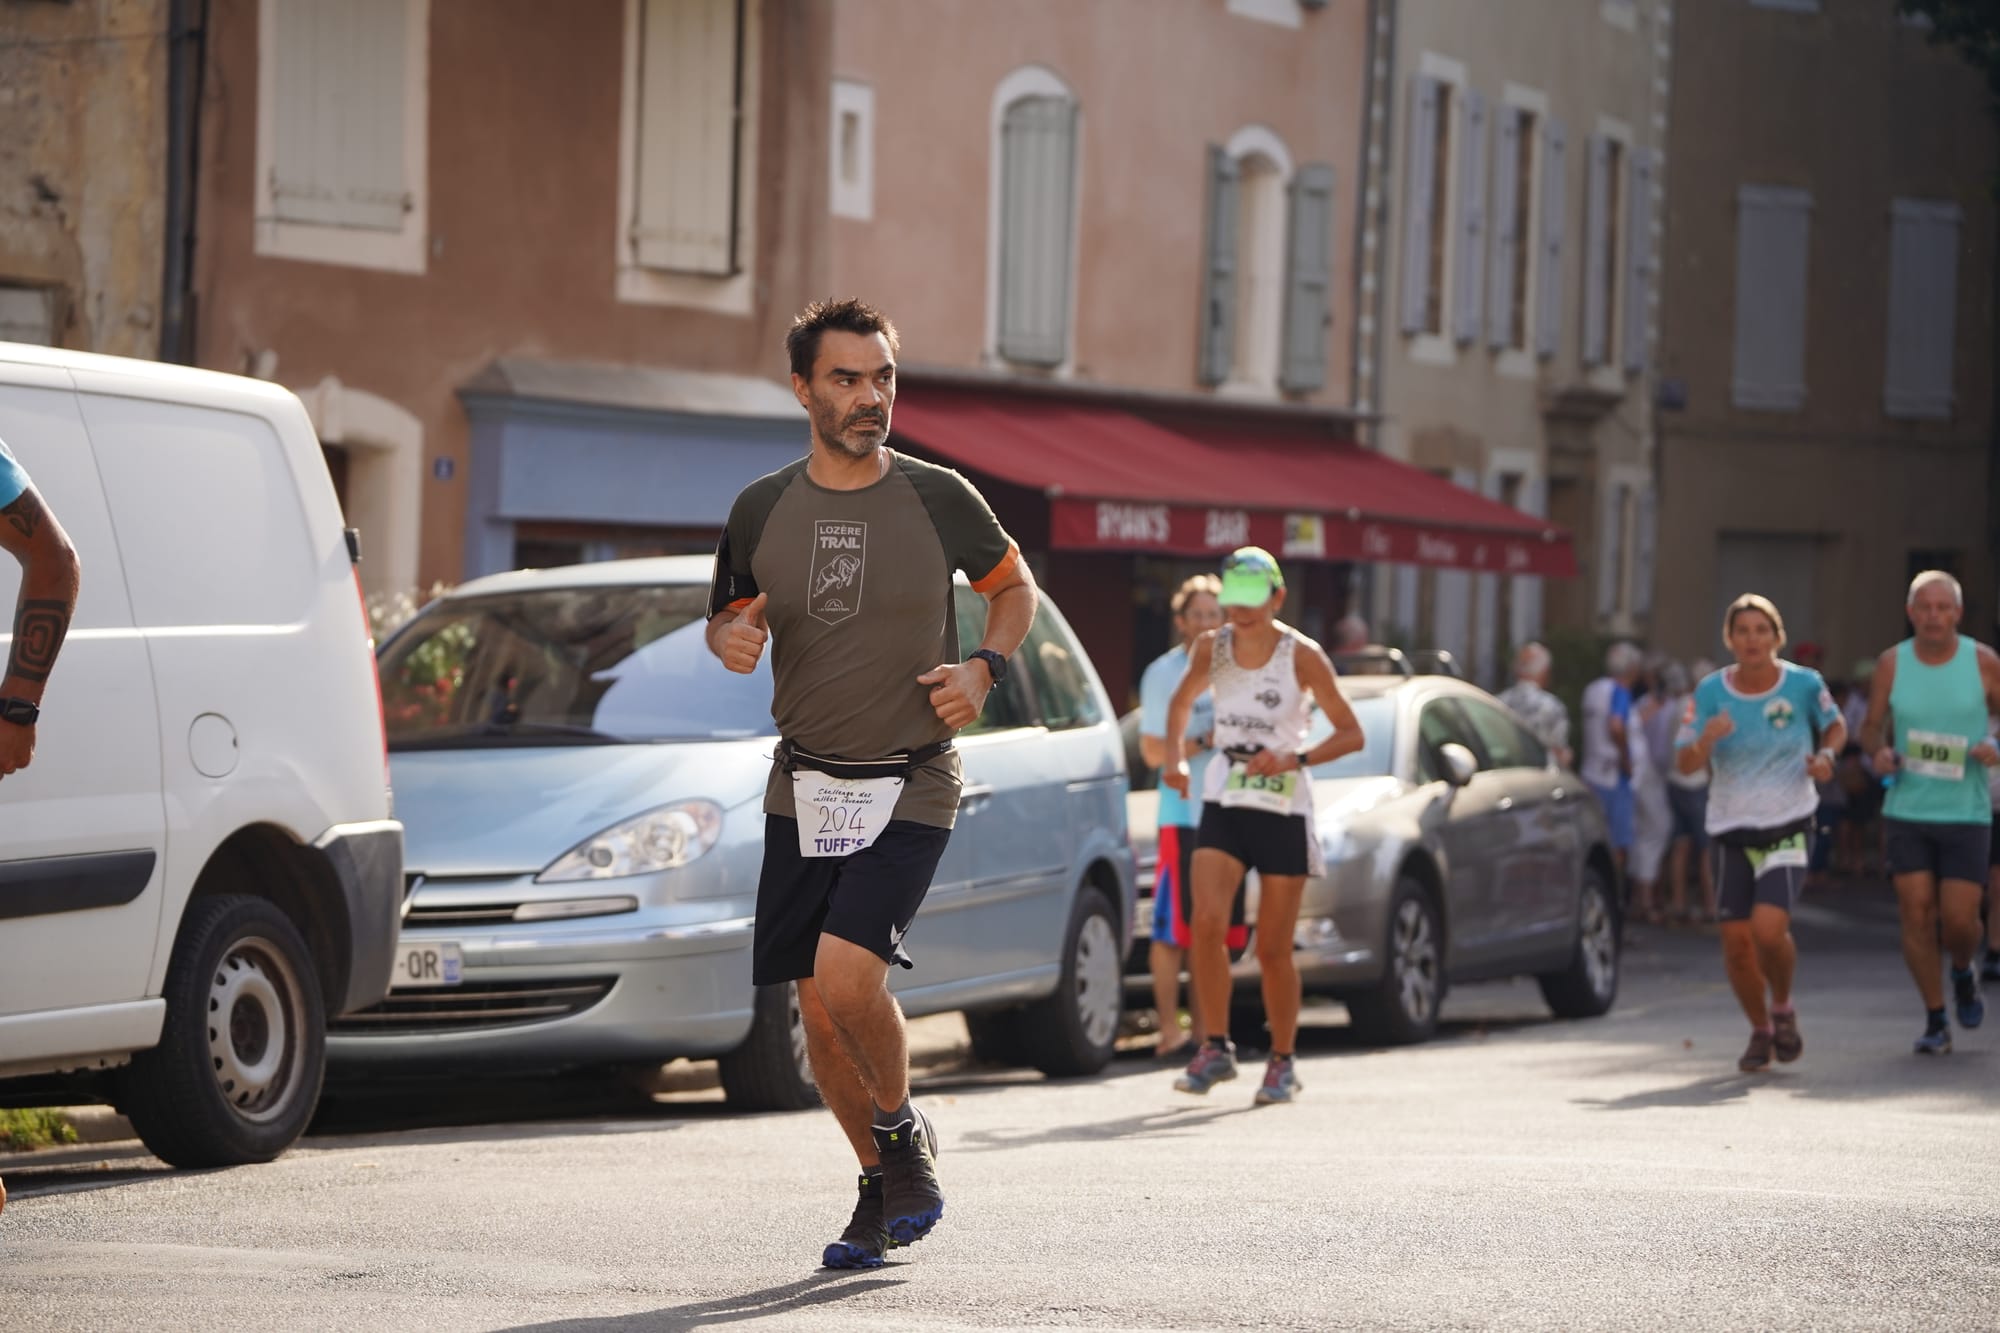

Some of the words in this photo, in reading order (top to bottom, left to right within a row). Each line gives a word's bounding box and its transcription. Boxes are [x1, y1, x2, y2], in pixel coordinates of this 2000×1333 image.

[819, 525, 862, 536] LOZÈRE
[1204, 508, 1250, 547] BAR
[820, 536, 861, 549] TRAIL
[1921, 743, 1950, 763] 99
[818, 788, 854, 799] Challenge
[818, 805, 865, 834] 204
[814, 838, 866, 853] TUFF'S
